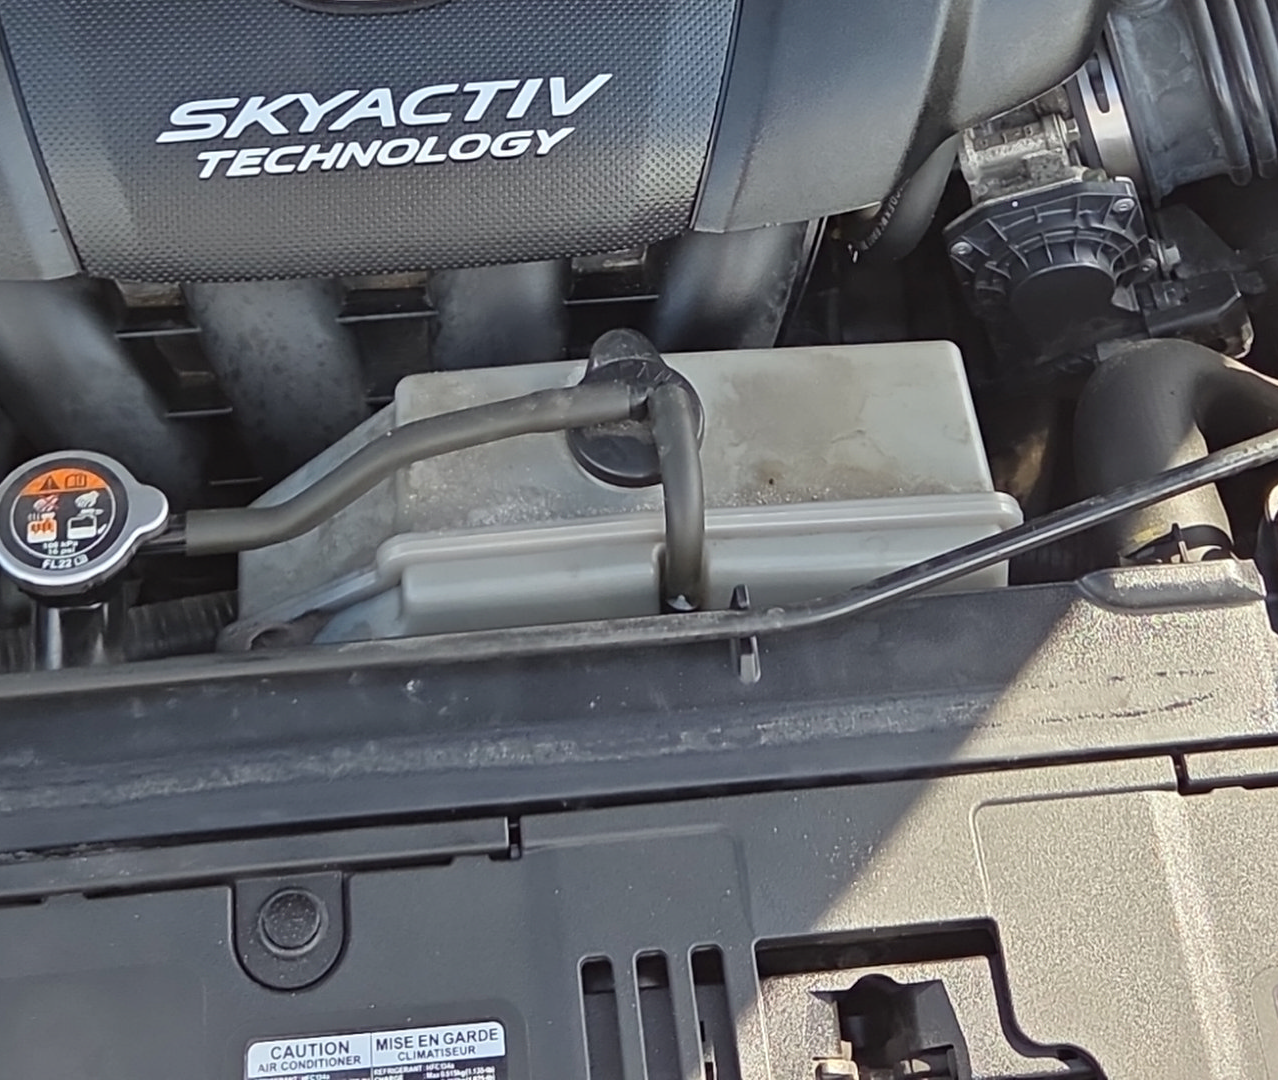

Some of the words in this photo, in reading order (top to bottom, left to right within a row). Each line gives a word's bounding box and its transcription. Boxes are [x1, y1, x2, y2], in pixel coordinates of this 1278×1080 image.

[155, 73, 613, 144] SKYACTIV
[197, 127, 576, 180] TECHNOLOGY
[42, 558, 72, 569] FL22
[375, 1036, 413, 1051] MISE
[420, 1032, 440, 1047] EN
[443, 1028, 499, 1046] GARDE
[270, 1040, 351, 1060] CAUTION
[397, 1045, 477, 1062] CLIMATISEUR
[257, 1062, 278, 1073] AIR
[281, 1055, 362, 1071] CONDITIONER
